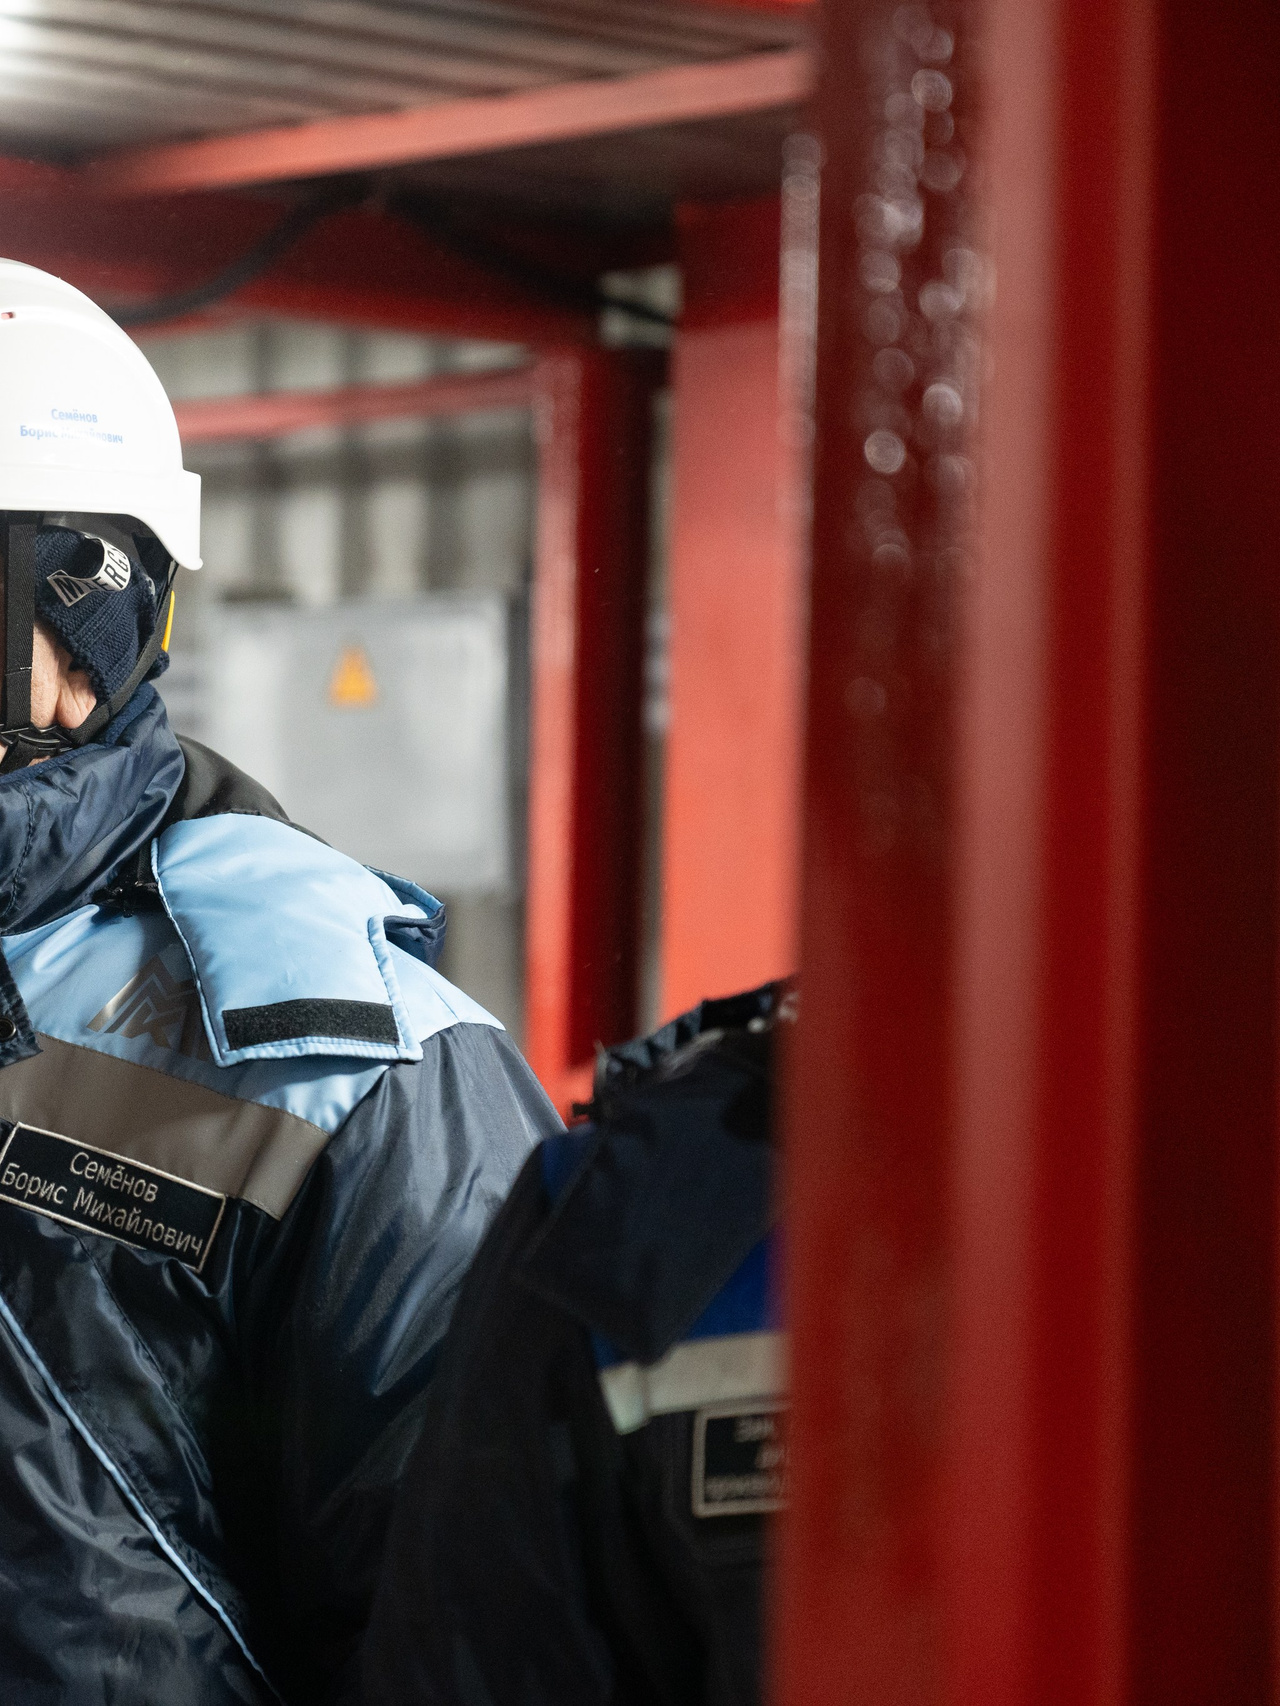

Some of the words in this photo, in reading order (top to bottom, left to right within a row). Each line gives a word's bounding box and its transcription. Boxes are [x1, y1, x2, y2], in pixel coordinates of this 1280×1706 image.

[51, 408, 98, 423] Семёнов
[70, 1151, 159, 1203] Семёнов
[0, 1162, 68, 1205] Борис
[72, 1186, 205, 1257] Михайлович
